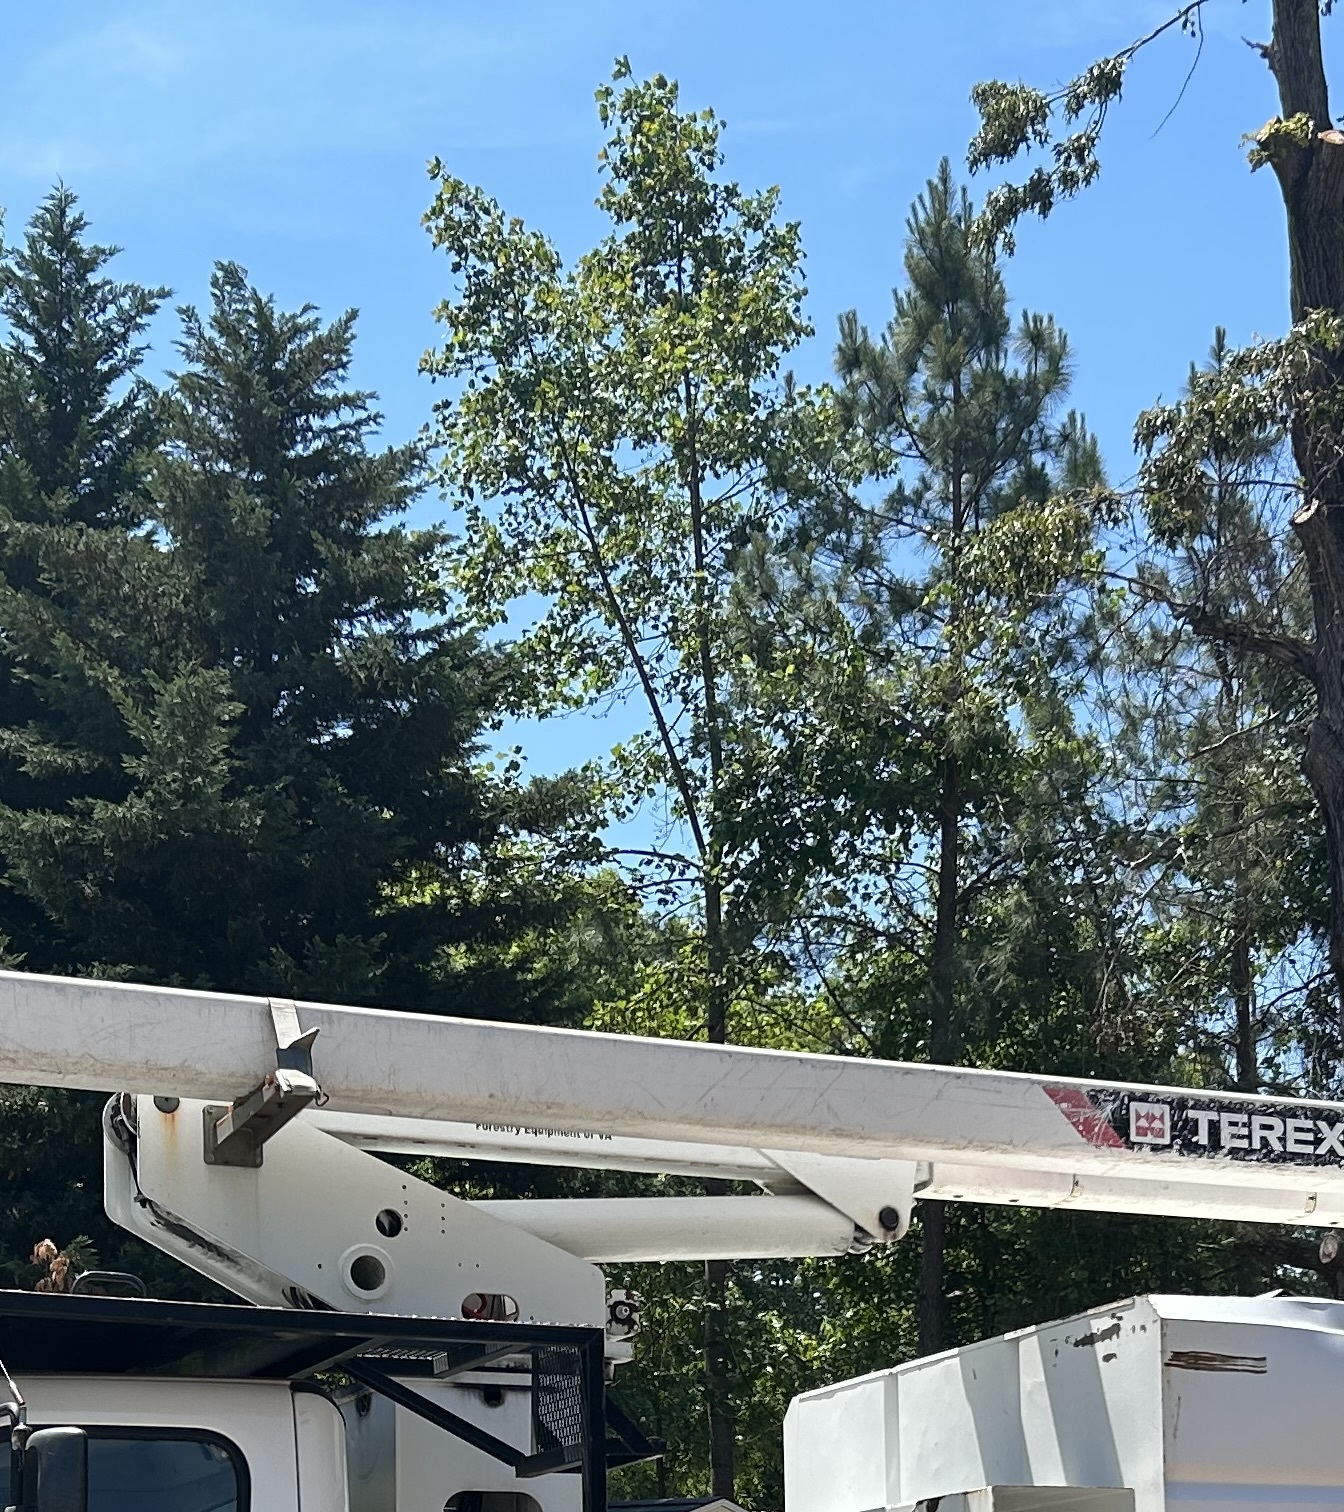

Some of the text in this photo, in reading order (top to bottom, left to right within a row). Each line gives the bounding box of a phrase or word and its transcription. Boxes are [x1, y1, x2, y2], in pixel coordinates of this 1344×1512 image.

[475, 1122, 521, 1136] Forestry
[524, 1126, 581, 1139] Equipment
[598, 1132, 612, 1141] VA
